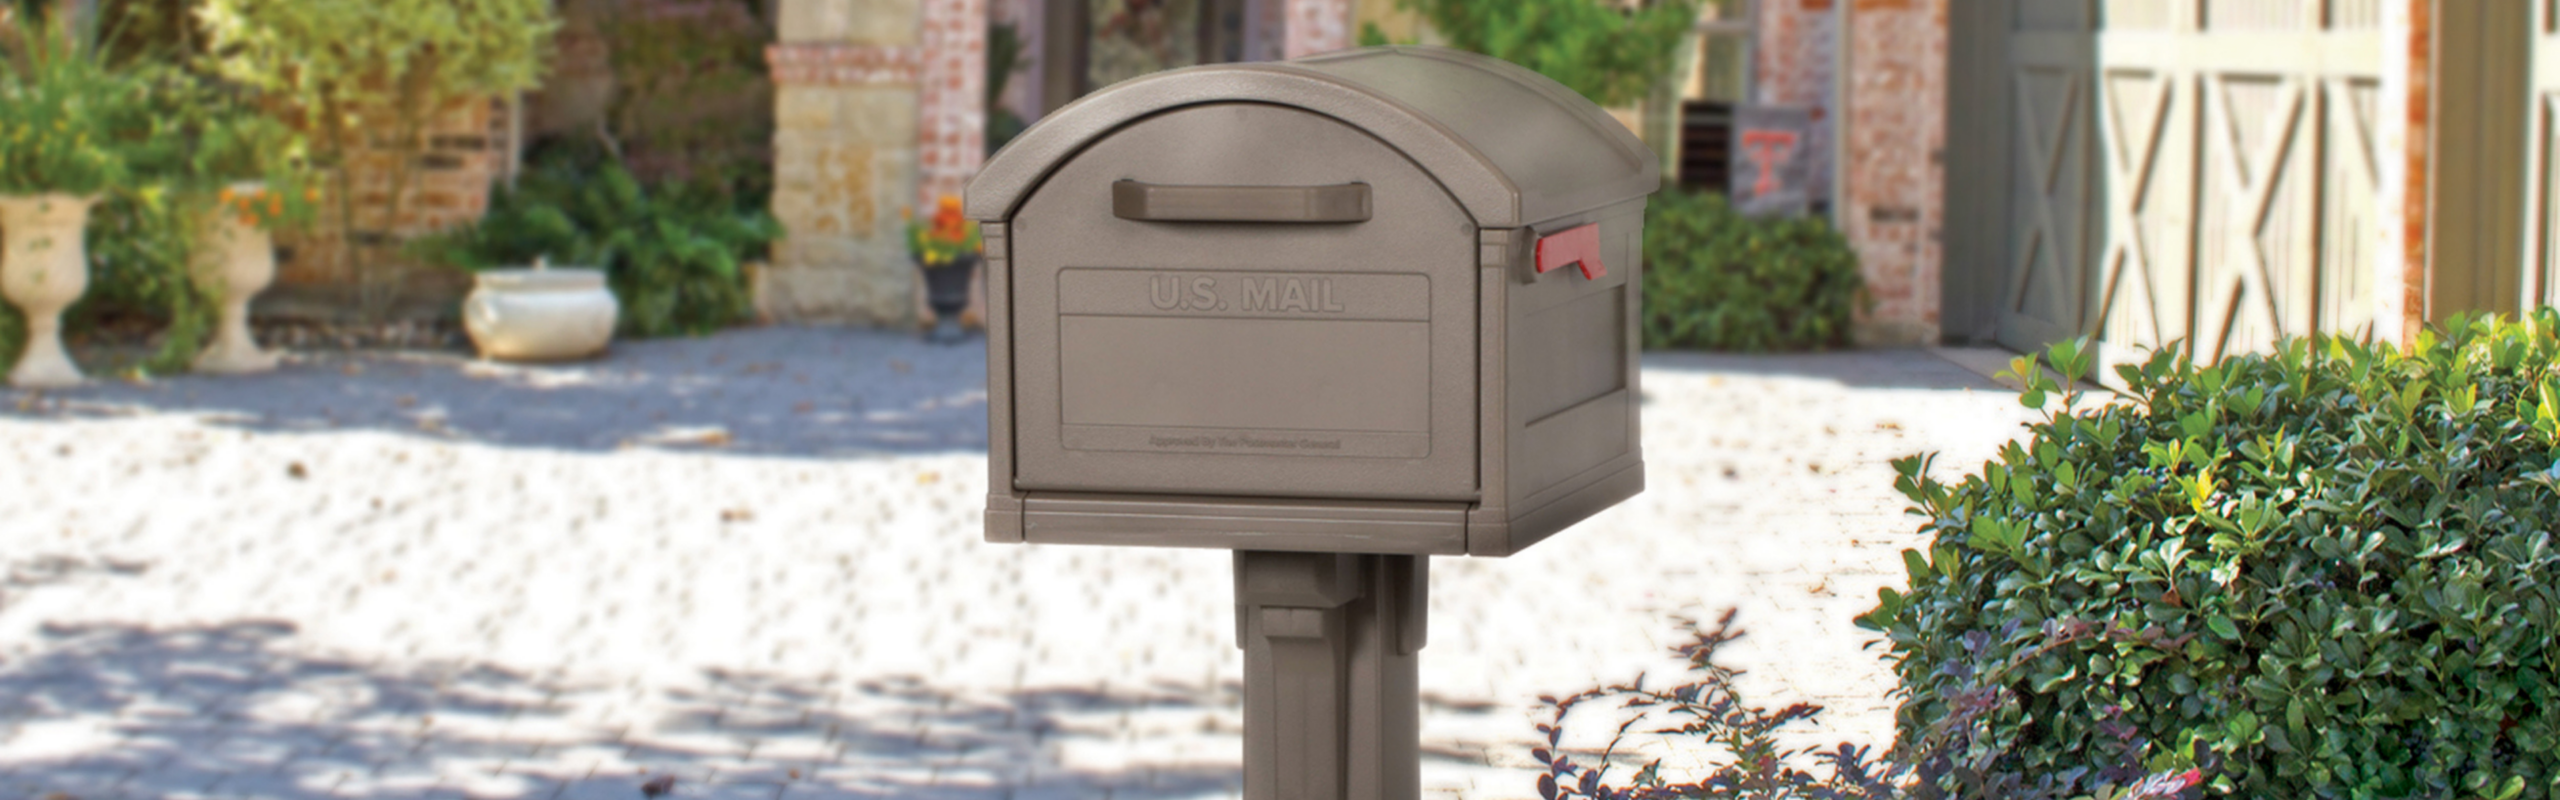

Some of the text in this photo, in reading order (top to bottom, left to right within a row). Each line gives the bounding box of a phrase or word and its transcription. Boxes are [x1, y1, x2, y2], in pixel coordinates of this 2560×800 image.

[1149, 275, 1345, 313] U.S. MAIL
[1149, 434, 1200, 448] Approved
